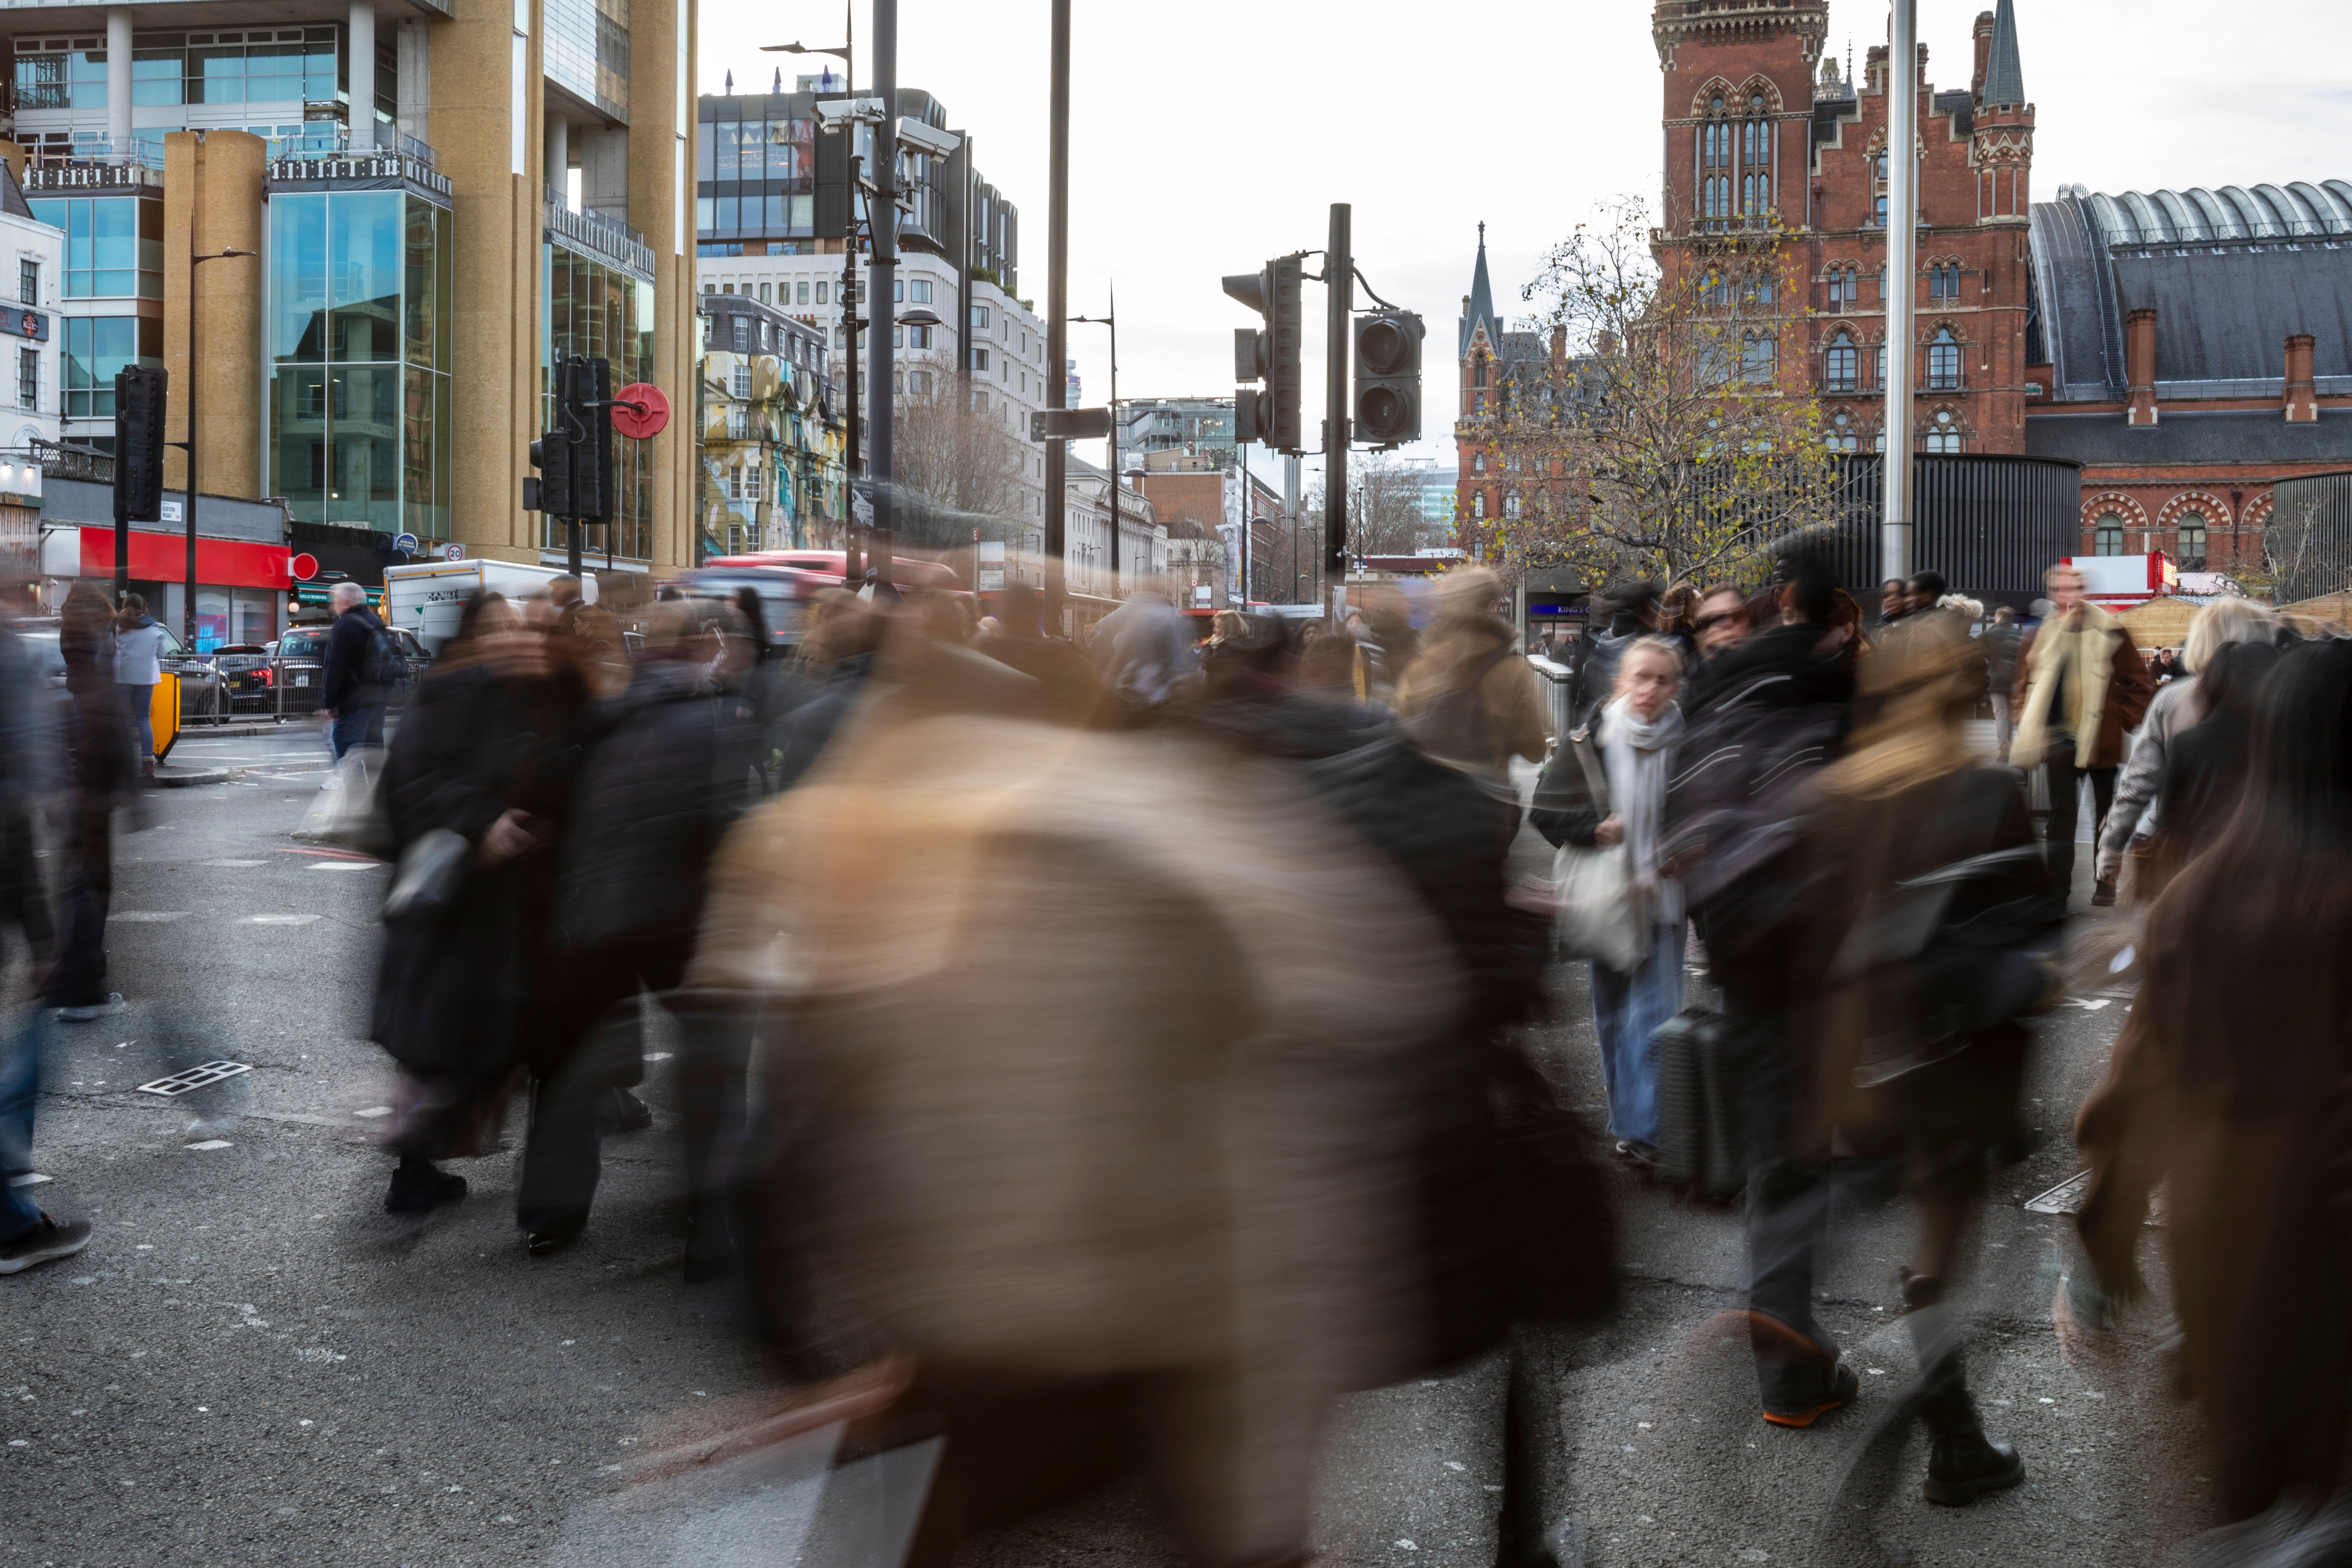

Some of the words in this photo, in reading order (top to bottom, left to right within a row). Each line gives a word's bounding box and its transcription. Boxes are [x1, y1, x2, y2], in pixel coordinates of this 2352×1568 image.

[4, 493, 24, 505] Noodles
[862, 490, 873, 499] CCTV
[973, 530, 977, 540] E
